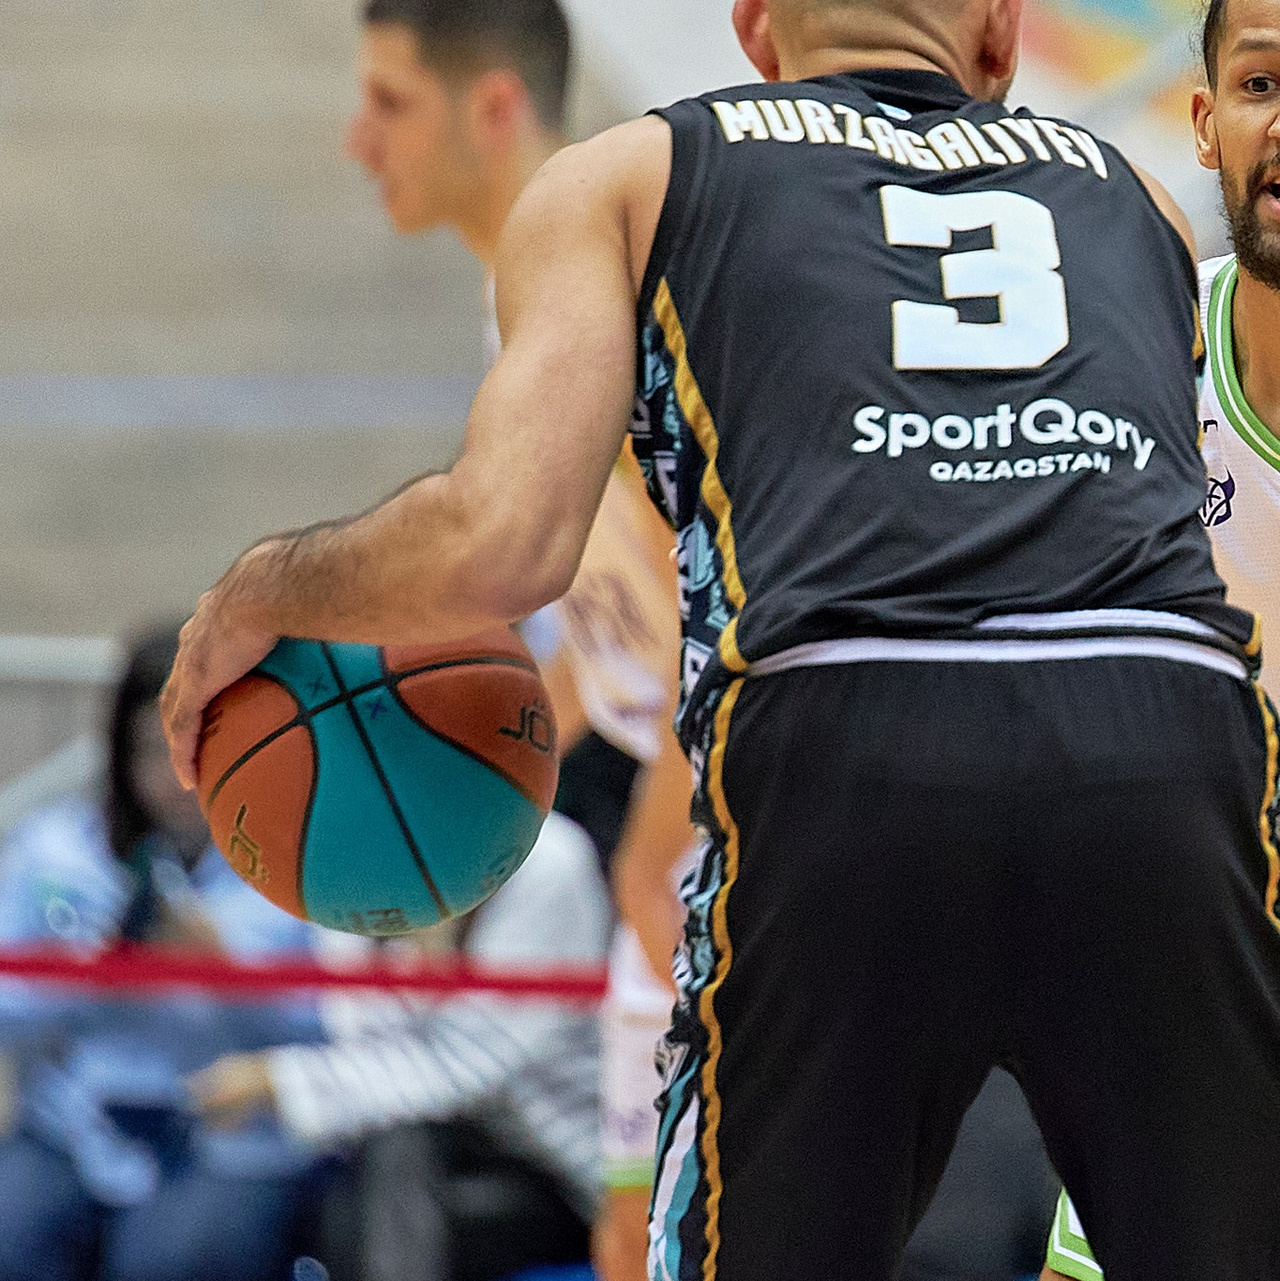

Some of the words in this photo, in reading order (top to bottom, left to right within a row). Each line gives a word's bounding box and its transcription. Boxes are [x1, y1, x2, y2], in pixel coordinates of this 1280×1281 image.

[711, 99, 1108, 180] MURZAGALIYEV
[879, 184, 1070, 371] 3
[852, 398, 1156, 471] SportQory
[930, 454, 1112, 481] QAZAQSTAN
